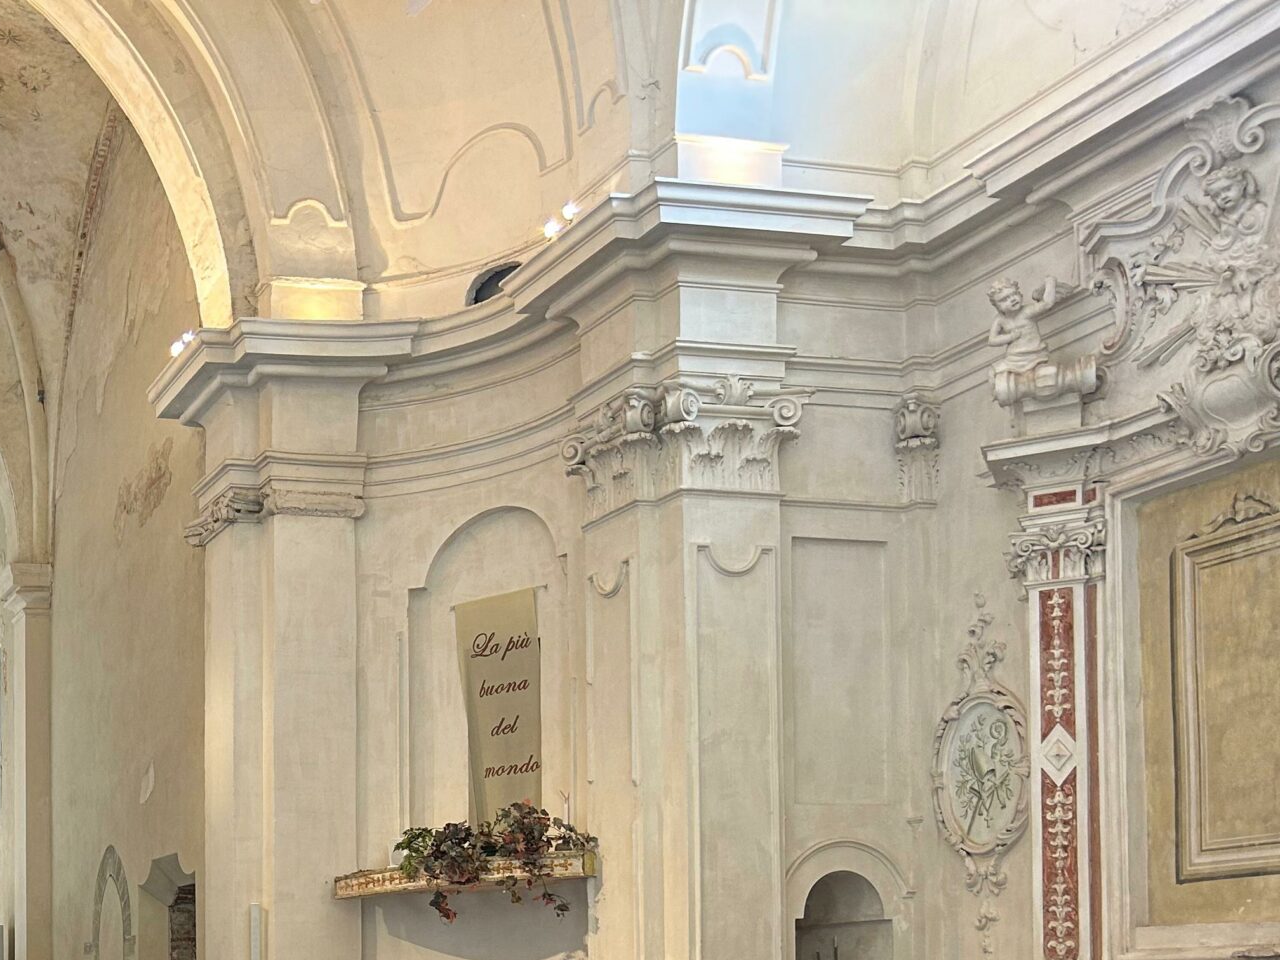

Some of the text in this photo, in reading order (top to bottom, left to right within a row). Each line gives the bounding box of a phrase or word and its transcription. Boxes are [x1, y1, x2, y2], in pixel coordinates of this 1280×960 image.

[470, 631, 532, 661] La più
[479, 678, 530, 698] buona
[490, 714, 520, 737] del
[484, 754, 541, 779] mondo
